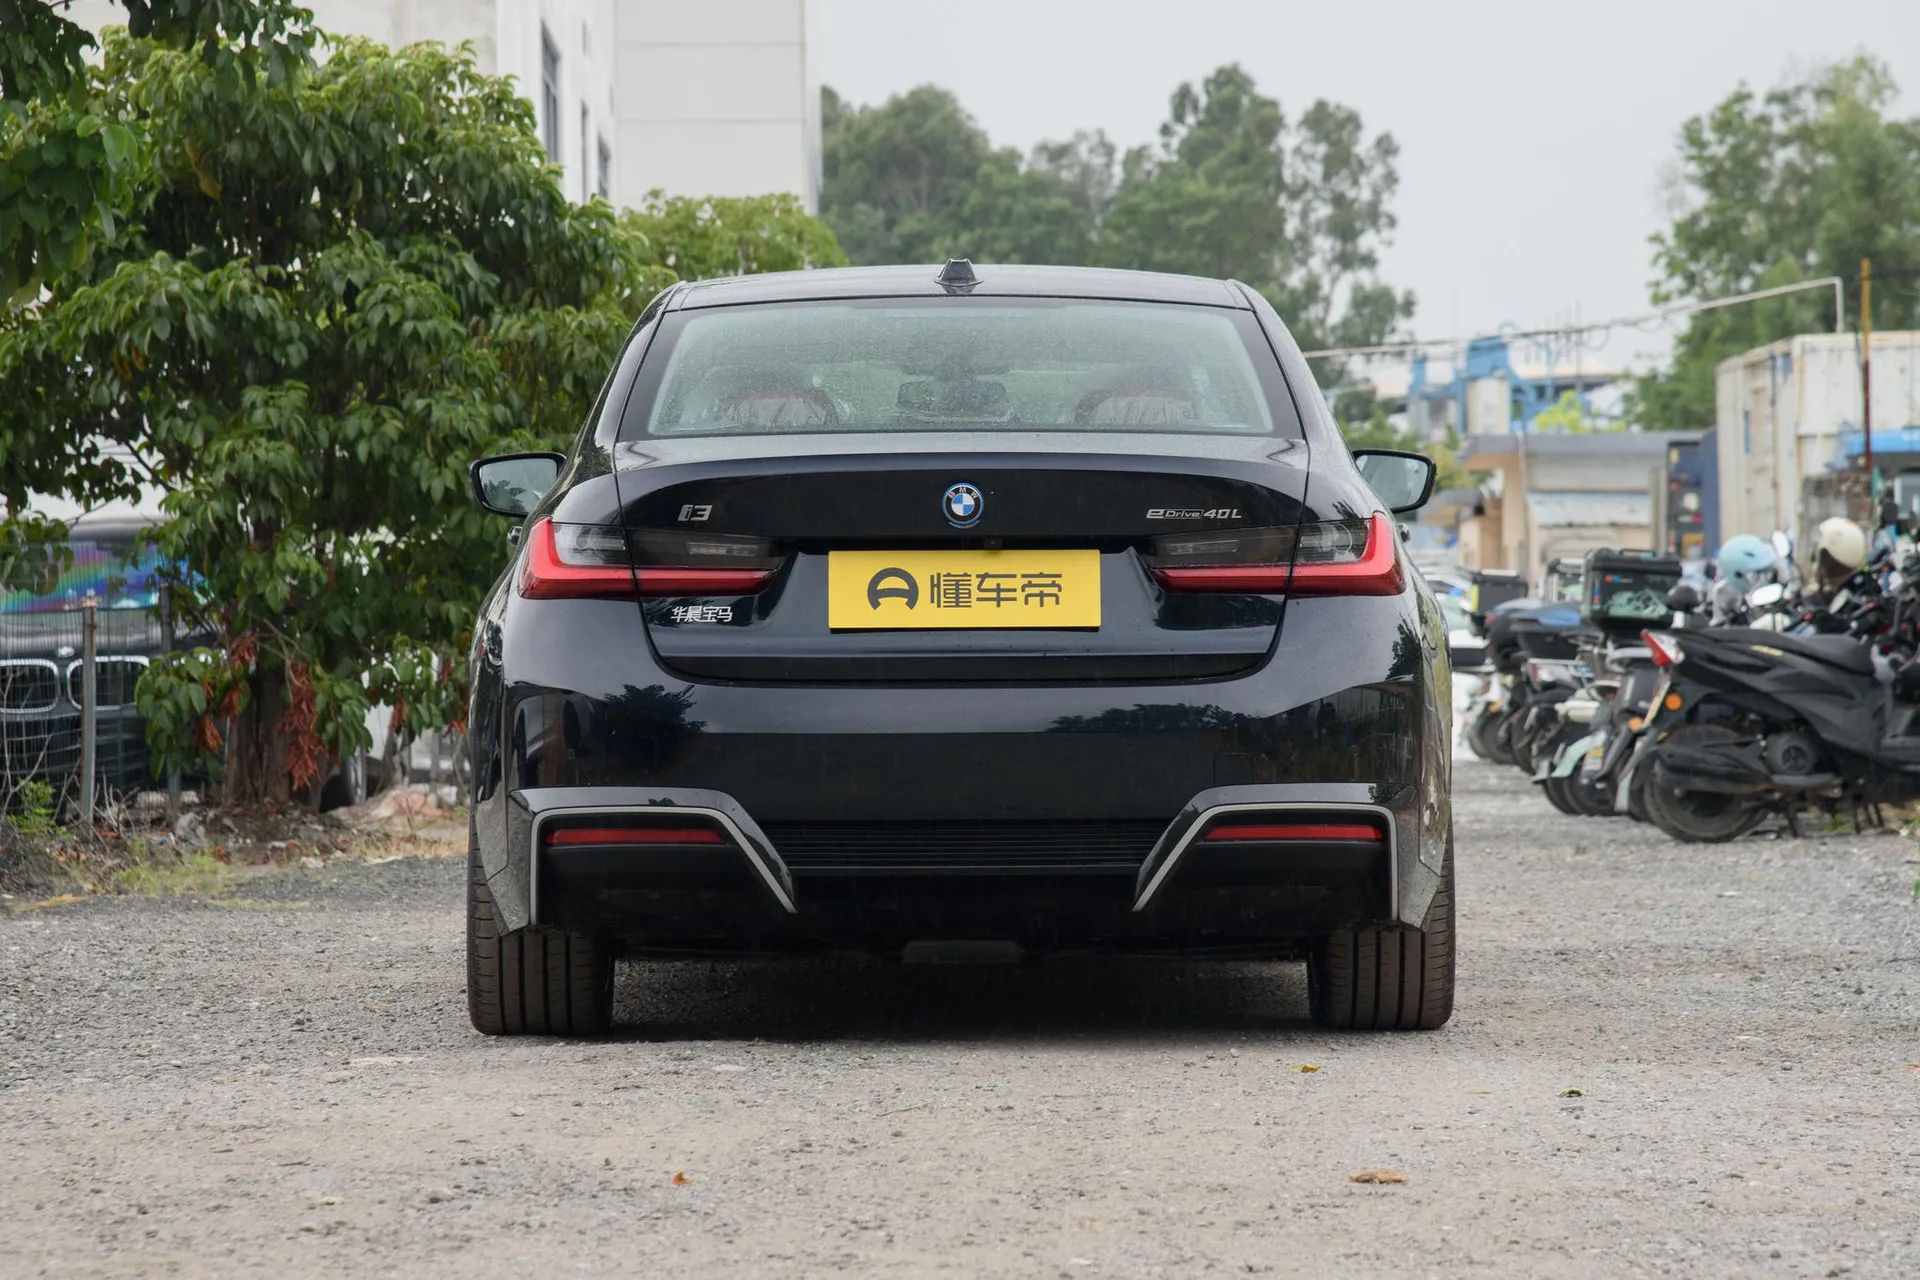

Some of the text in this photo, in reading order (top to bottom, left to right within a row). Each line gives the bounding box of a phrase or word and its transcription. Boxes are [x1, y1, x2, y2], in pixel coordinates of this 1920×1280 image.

[677, 504, 713, 522] i3
[929, 571, 1063, 608] 懂车帝
[670, 605, 733, 623] 华晨宝马
